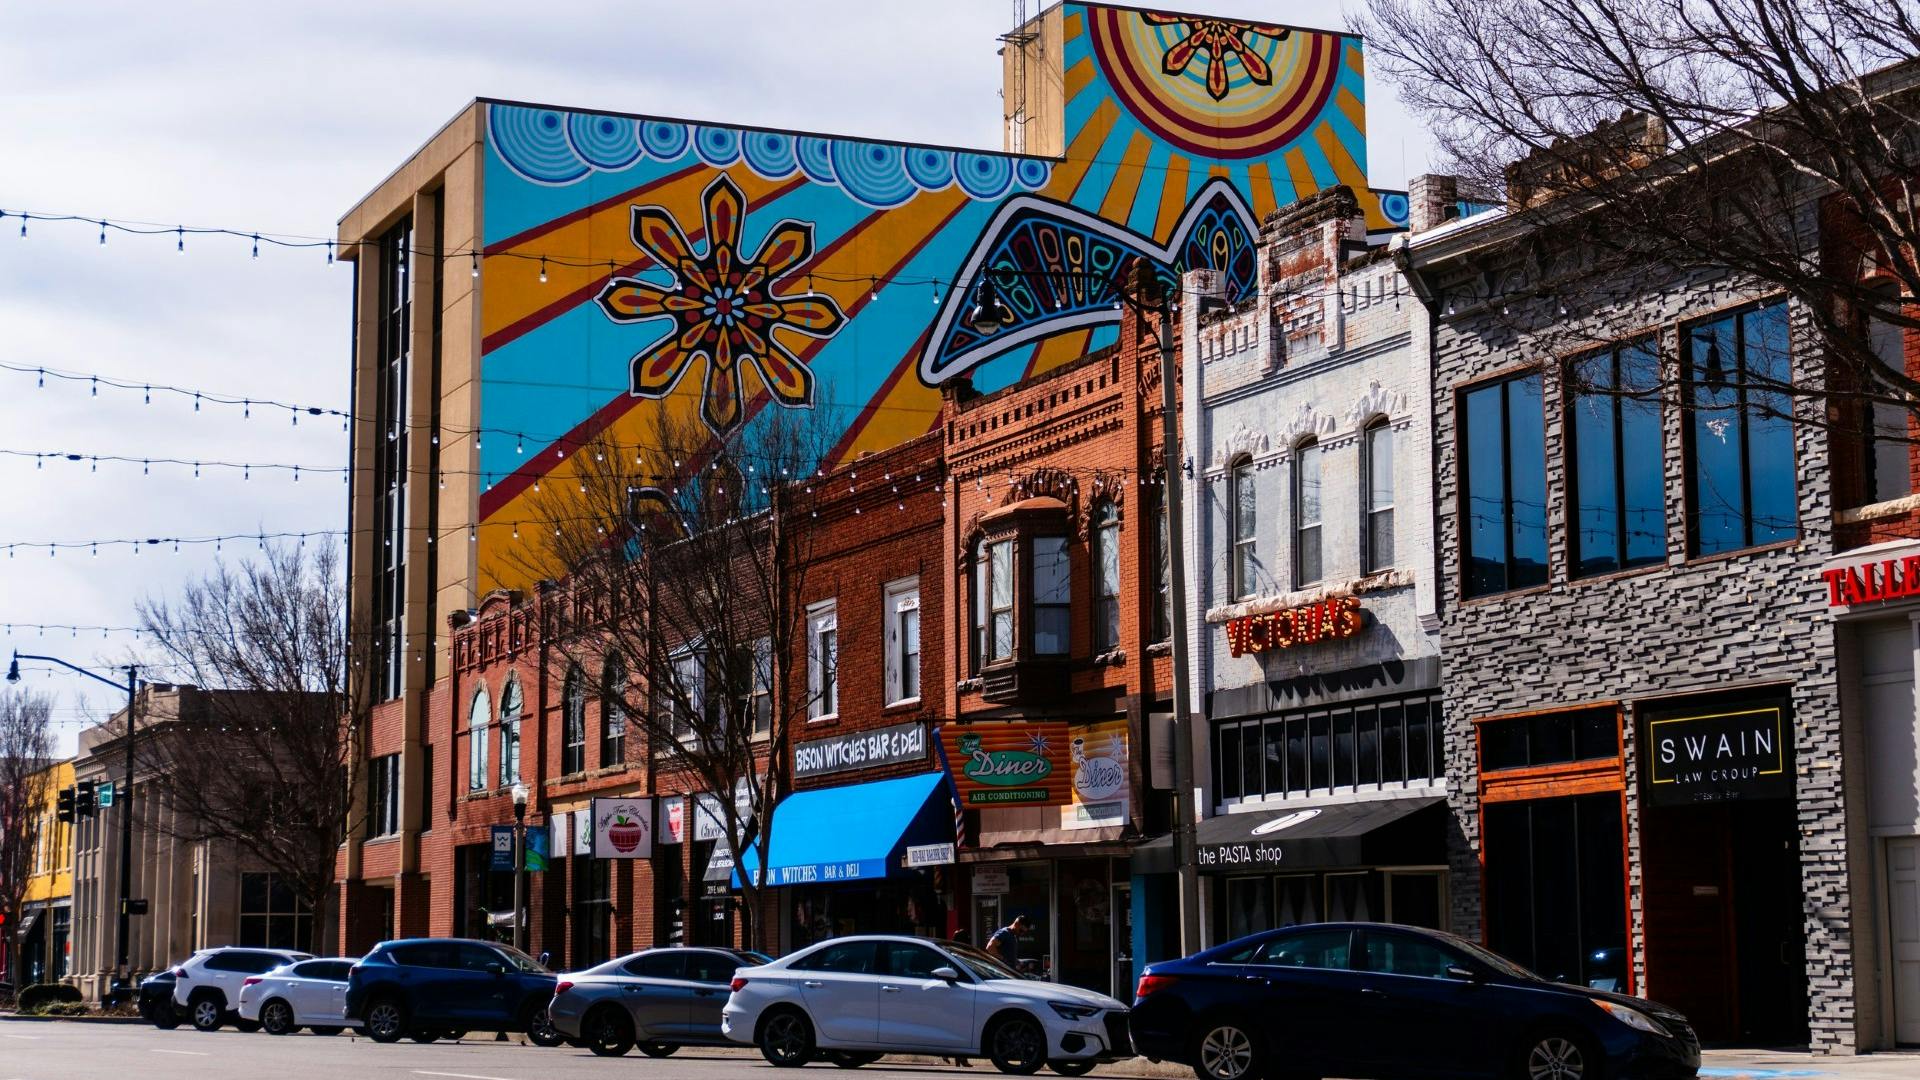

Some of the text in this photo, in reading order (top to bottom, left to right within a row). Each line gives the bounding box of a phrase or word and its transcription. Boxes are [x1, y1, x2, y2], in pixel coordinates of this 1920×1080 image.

[1138, 362, 1182, 396] FIDELY
[1822, 555, 1920, 607] TALLE
[1226, 597, 1361, 658] VICTORIA'S
[796, 728, 923, 771] BISON WITCHES BAR & DELI
[1661, 728, 1771, 763] SWAIN
[970, 750, 1047, 776] Diner
[1077, 757, 1122, 789] Diner
[1676, 767, 1758, 784] LAW GROUP
[972, 791, 1046, 801] AIR CONDITIONING
[1198, 843, 1282, 865] the PASTA shop
[753, 863, 860, 886] BON WITCHES BAR & DELI
